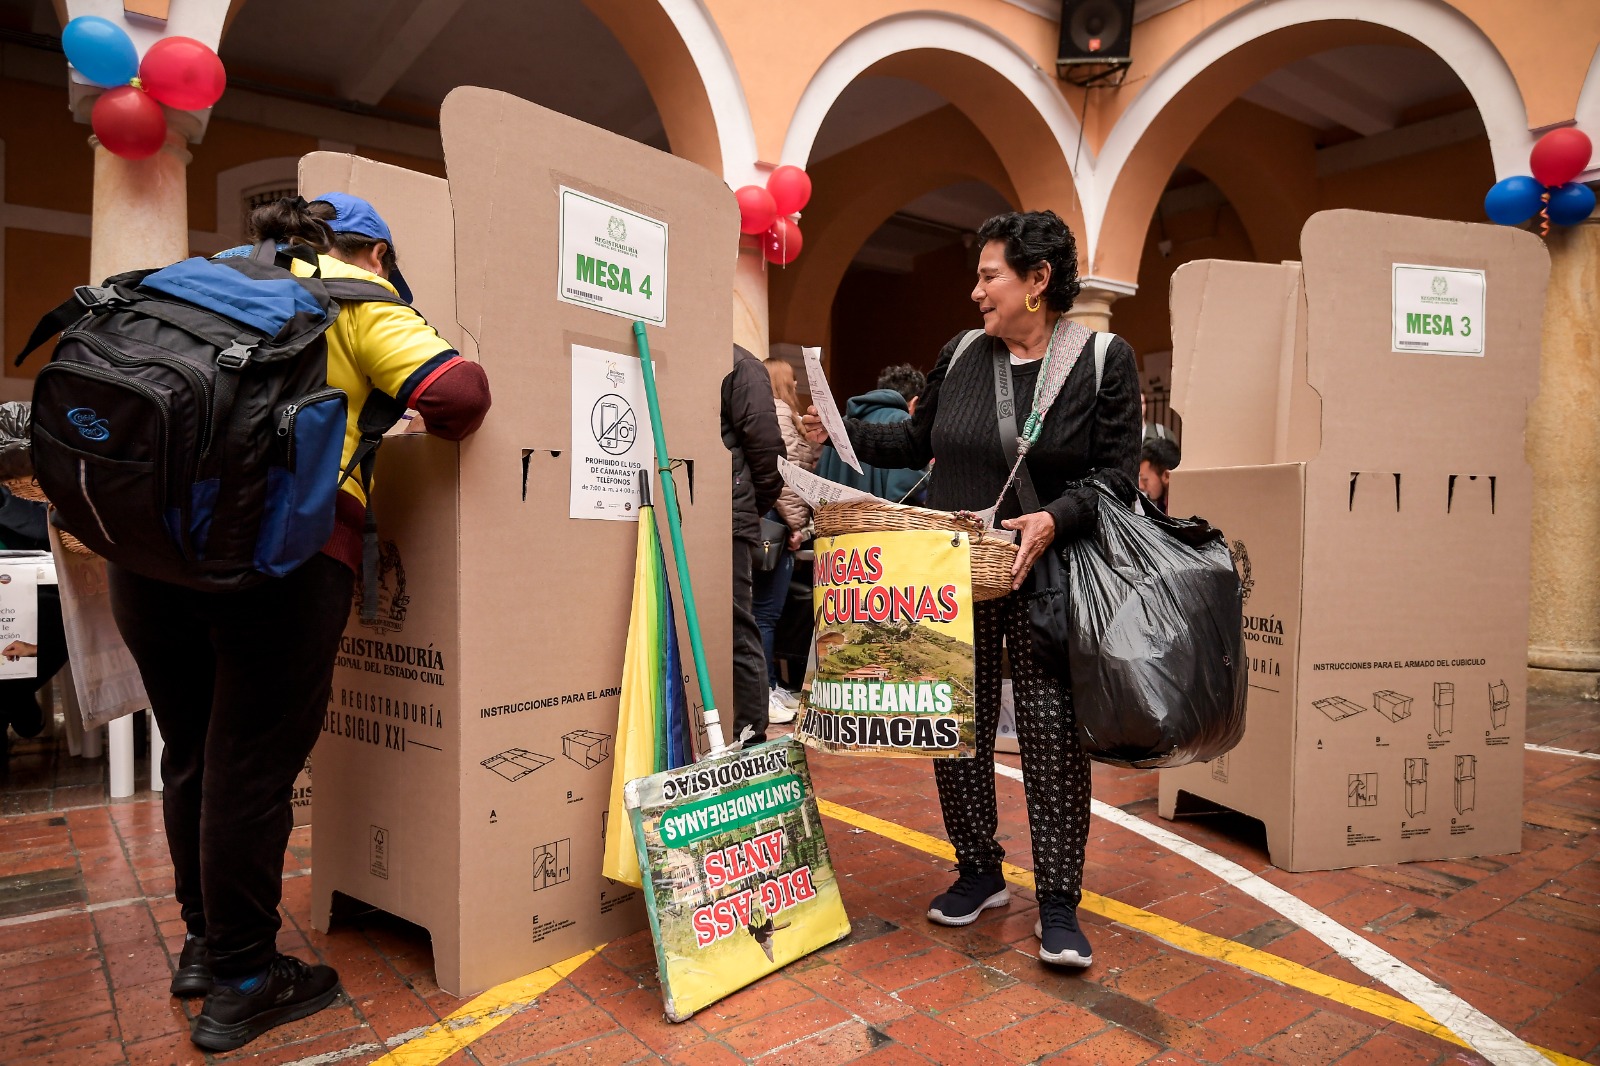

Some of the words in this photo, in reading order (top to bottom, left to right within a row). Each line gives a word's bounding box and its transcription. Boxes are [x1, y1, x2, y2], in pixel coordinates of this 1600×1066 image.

[576, 253, 632, 295] MESA
[639, 274, 652, 300] 4
[1406, 312, 1454, 336] MESA
[1460, 316, 1471, 337] 3
[586, 457, 620, 466] PROHIBIDO
[600, 467, 630, 476] CÁMARAS
[596, 476, 631, 485] TELÉFONOS
[822, 584, 959, 624] CULONAS
[340, 636, 445, 670] GISTRADURÍA
[1262, 634, 1284, 646] CIVIL
[364, 660, 381, 674] DEL
[384, 665, 418, 681] ESTADO
[420, 672, 445, 686] CIVIL
[1313, 662, 1372, 671] INSTRUCCIONES
[1373, 661, 1392, 669] PARA
[1451, 658, 1486, 666] CUBICULO
[342, 689, 442, 729] REGISTRADURÍA
[480, 697, 559, 718] INSTRUCCIONES
[561, 693, 585, 704] PARA
[587, 691, 597, 700] EL
[346, 715, 380, 745] SIGLO
[386, 725, 406, 752] XXI
[663, 750, 790, 801] APHRODISIAC
[567, 790, 572, 799] B
[490, 809, 496, 818] A
[666, 780, 801, 841] SANTANDEREANAS
[704, 829, 786, 890] ANTS
[760, 865, 817, 918] BIG
[532, 915, 538, 925] E
[692, 889, 755, 950] ASS
